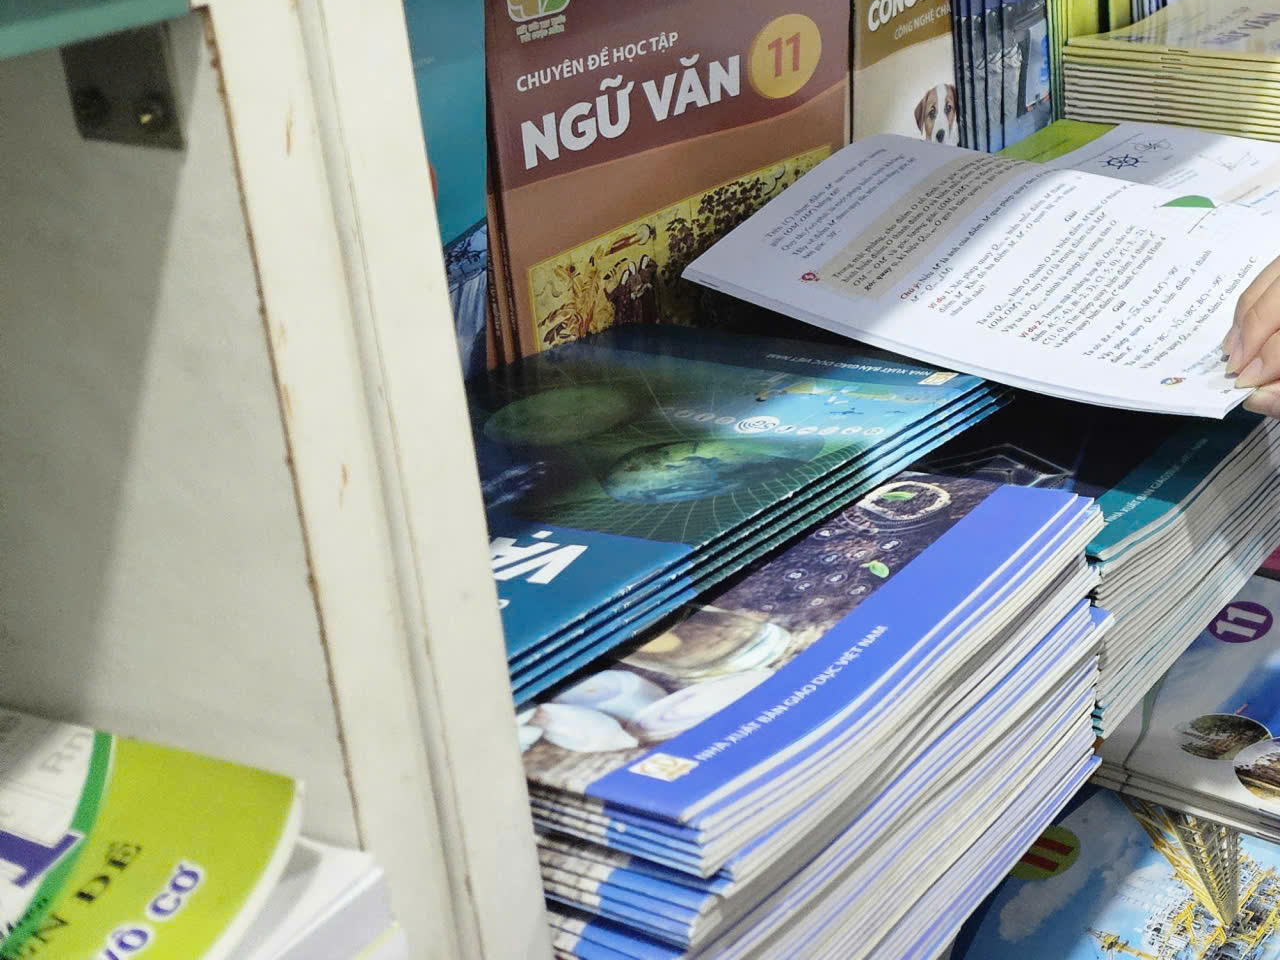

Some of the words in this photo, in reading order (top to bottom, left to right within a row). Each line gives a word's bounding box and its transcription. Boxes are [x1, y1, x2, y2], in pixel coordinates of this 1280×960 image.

[515, 57, 585, 94] CHUYÊN
[587, 46, 610, 71] ĐỀ
[611, 40, 648, 67] HỌC
[648, 30, 679, 55] TẬP
[767, 33, 801, 79] 11
[521, 74, 634, 171] NGỮ
[643, 54, 741, 123] VĂN
[1215, 604, 1268, 638] 11
[693, 740, 731, 762] NHÀ
[724, 721, 761, 744] XUẤT
[756, 703, 789, 725] BẢN
[783, 683, 817, 708] GIÁO
[810, 664, 843, 687] DỤC
[834, 645, 864, 667] VIỆT
[858, 624, 889, 648] NAM
